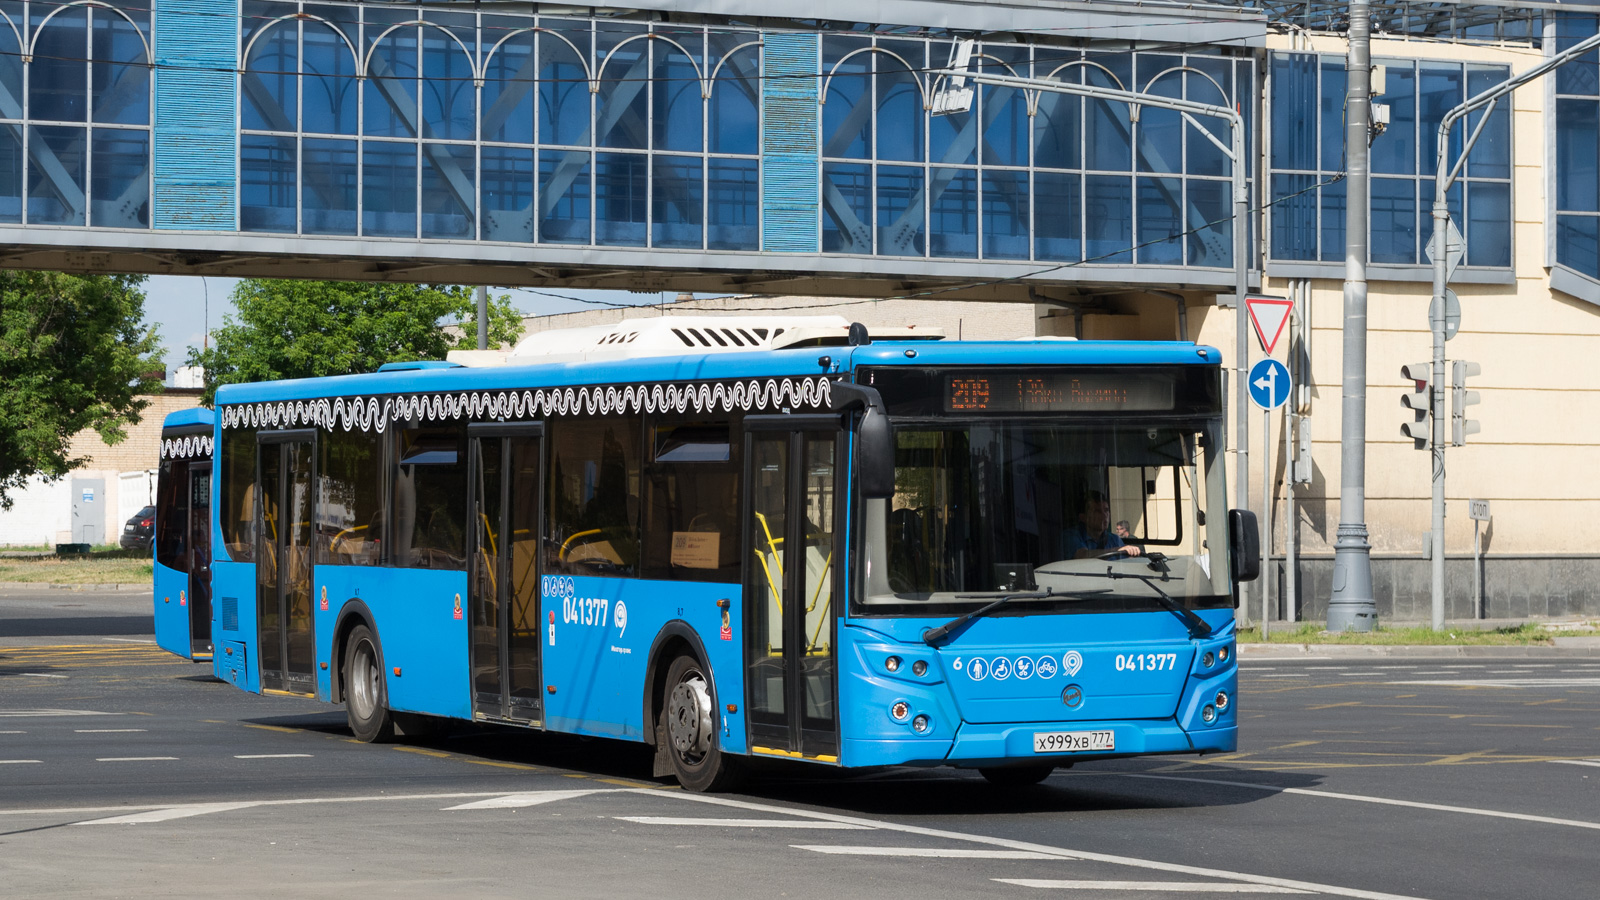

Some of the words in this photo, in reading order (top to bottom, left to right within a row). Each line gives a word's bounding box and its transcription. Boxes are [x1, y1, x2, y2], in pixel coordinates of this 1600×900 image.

[952, 379, 989, 409] 209
[1472, 502, 1487, 517] СТОП
[563, 596, 609, 627] 041377
[953, 656, 963, 671] 6
[1115, 652, 1177, 671] 041377
[1092, 732, 1111, 744] 777
